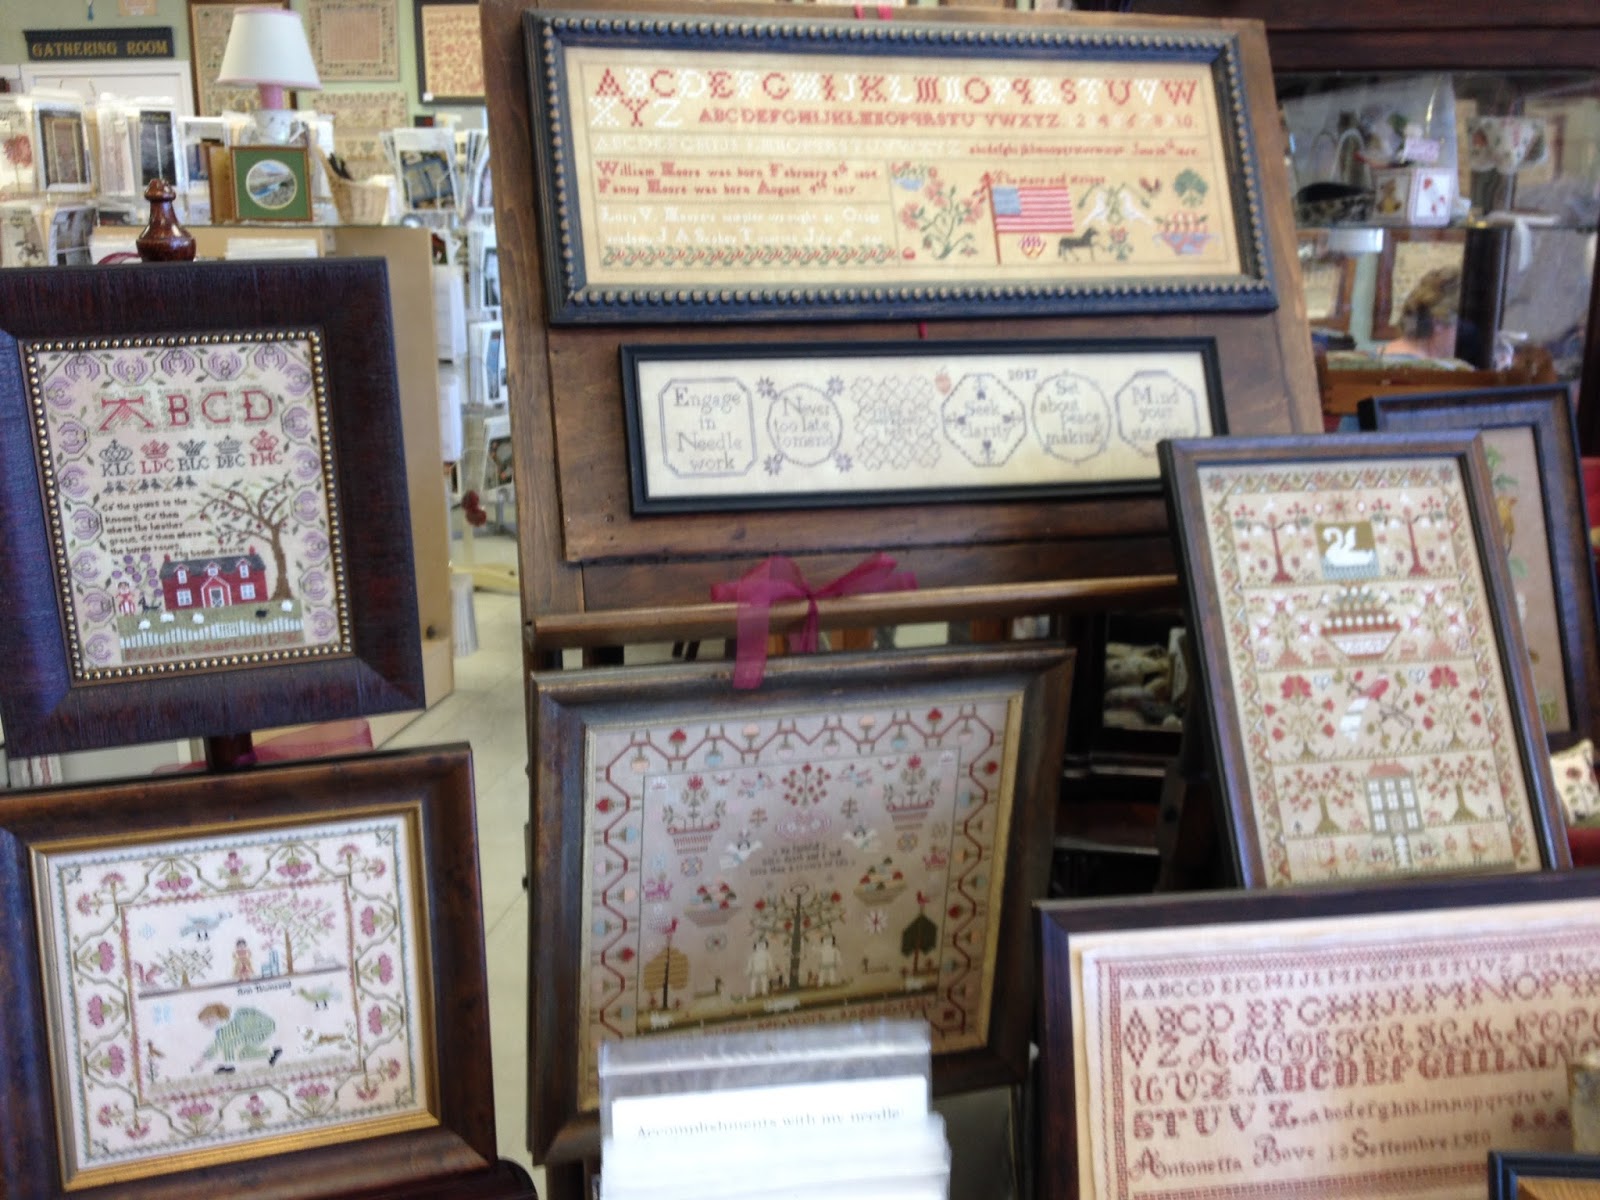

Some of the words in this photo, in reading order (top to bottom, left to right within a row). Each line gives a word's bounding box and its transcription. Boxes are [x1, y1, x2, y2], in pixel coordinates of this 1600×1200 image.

[32, 42, 117, 58] GATHERING
[127, 40, 168, 56] ROOM
[596, 161, 654, 176] William
[708, 168, 731, 177] was
[737, 166, 763, 178] born
[597, 178, 639, 196] Fanny
[694, 185, 718, 195] was
[723, 182, 750, 194] born
[757, 179, 800, 197] August
[674, 386, 742, 414] Engage
[784, 395, 830, 416] Never
[802, 415, 830, 432] late
[676, 431, 742, 452] Needle
[140, 459, 175, 475] LDC
[689, 451, 735, 470] work
[117, 501, 130, 510] the
[174, 498, 188, 506] the
[134, 523, 147, 532] the
[638, 1118, 777, 1138] Accomplishments
[783, 1113, 816, 1127] with
[822, 1112, 844, 1127] my
[850, 1105, 901, 1122] needle
